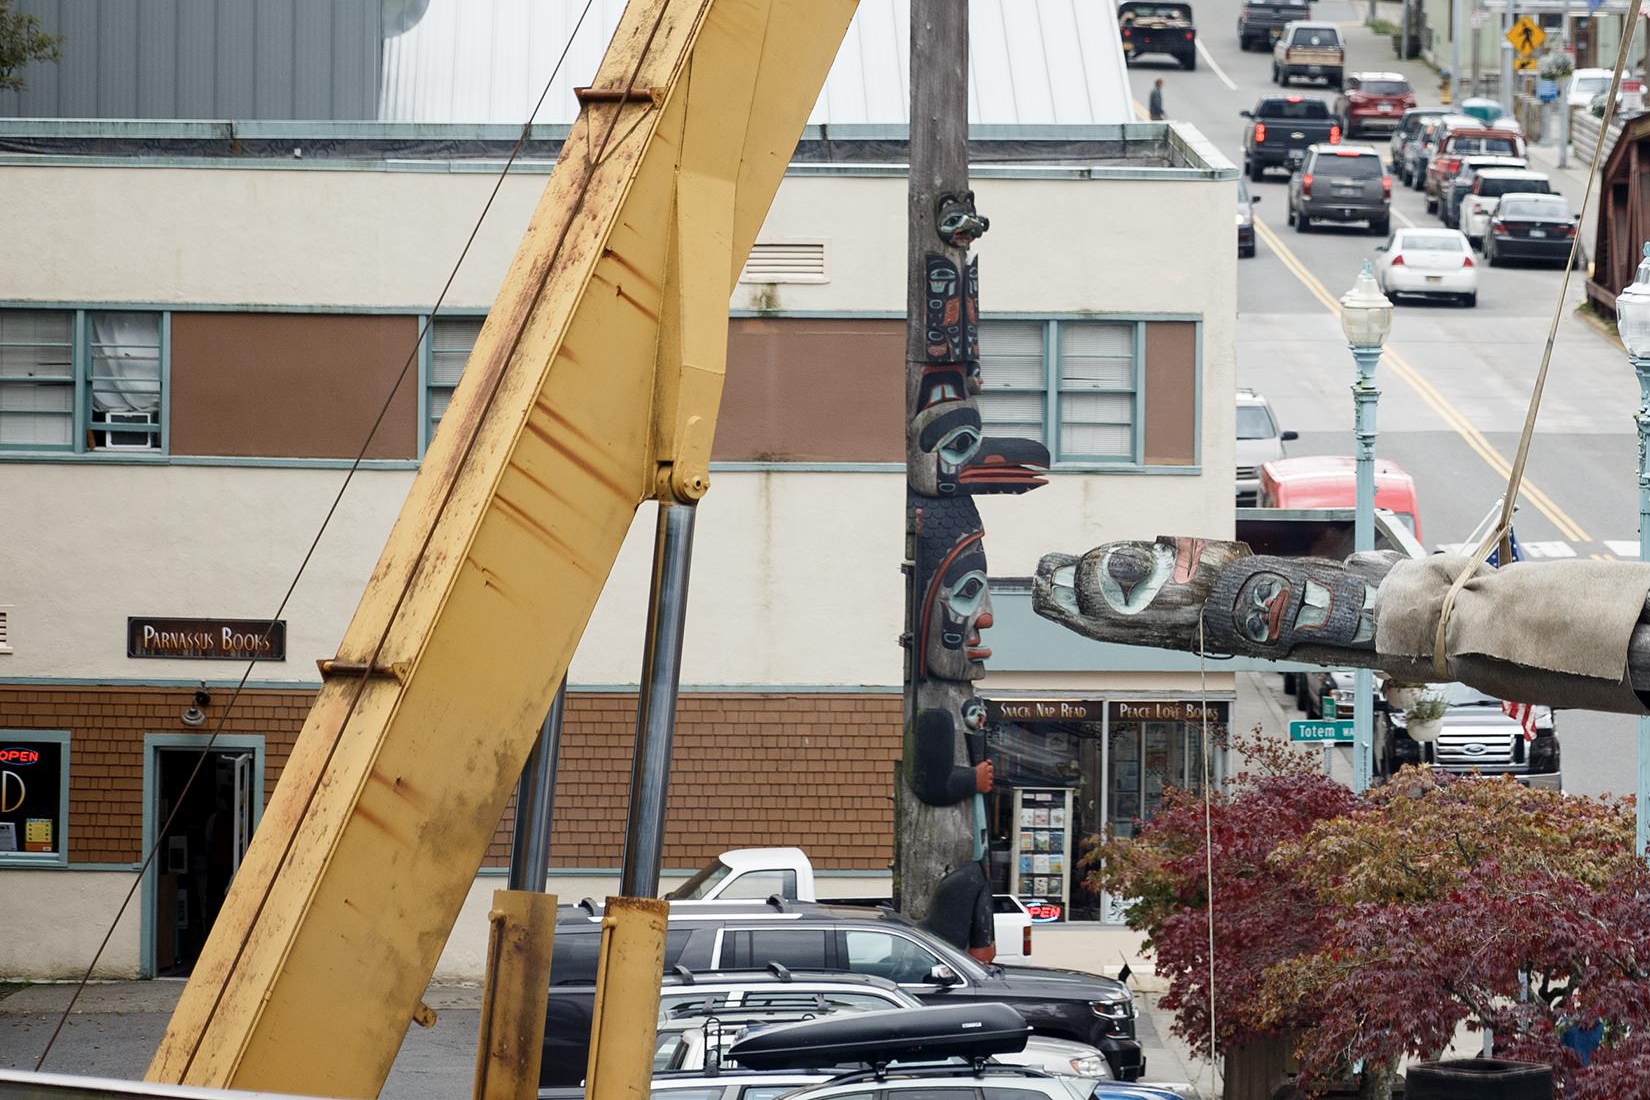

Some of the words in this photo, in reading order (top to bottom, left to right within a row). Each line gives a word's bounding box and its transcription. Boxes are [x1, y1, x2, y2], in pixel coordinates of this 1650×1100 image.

[143, 625, 214, 650] PARNASSUS
[221, 626, 270, 651] BOOKS
[1000, 702, 1031, 718] SNACK
[1037, 702, 1056, 718] NAP
[1060, 702, 1087, 718] READ
[1120, 703, 1150, 718] PEACE
[1299, 725, 1335, 737] Totem
[1342, 727, 1354, 737] WA
[0, 750, 39, 762] OPEN
[1025, 906, 1061, 918] PEN
